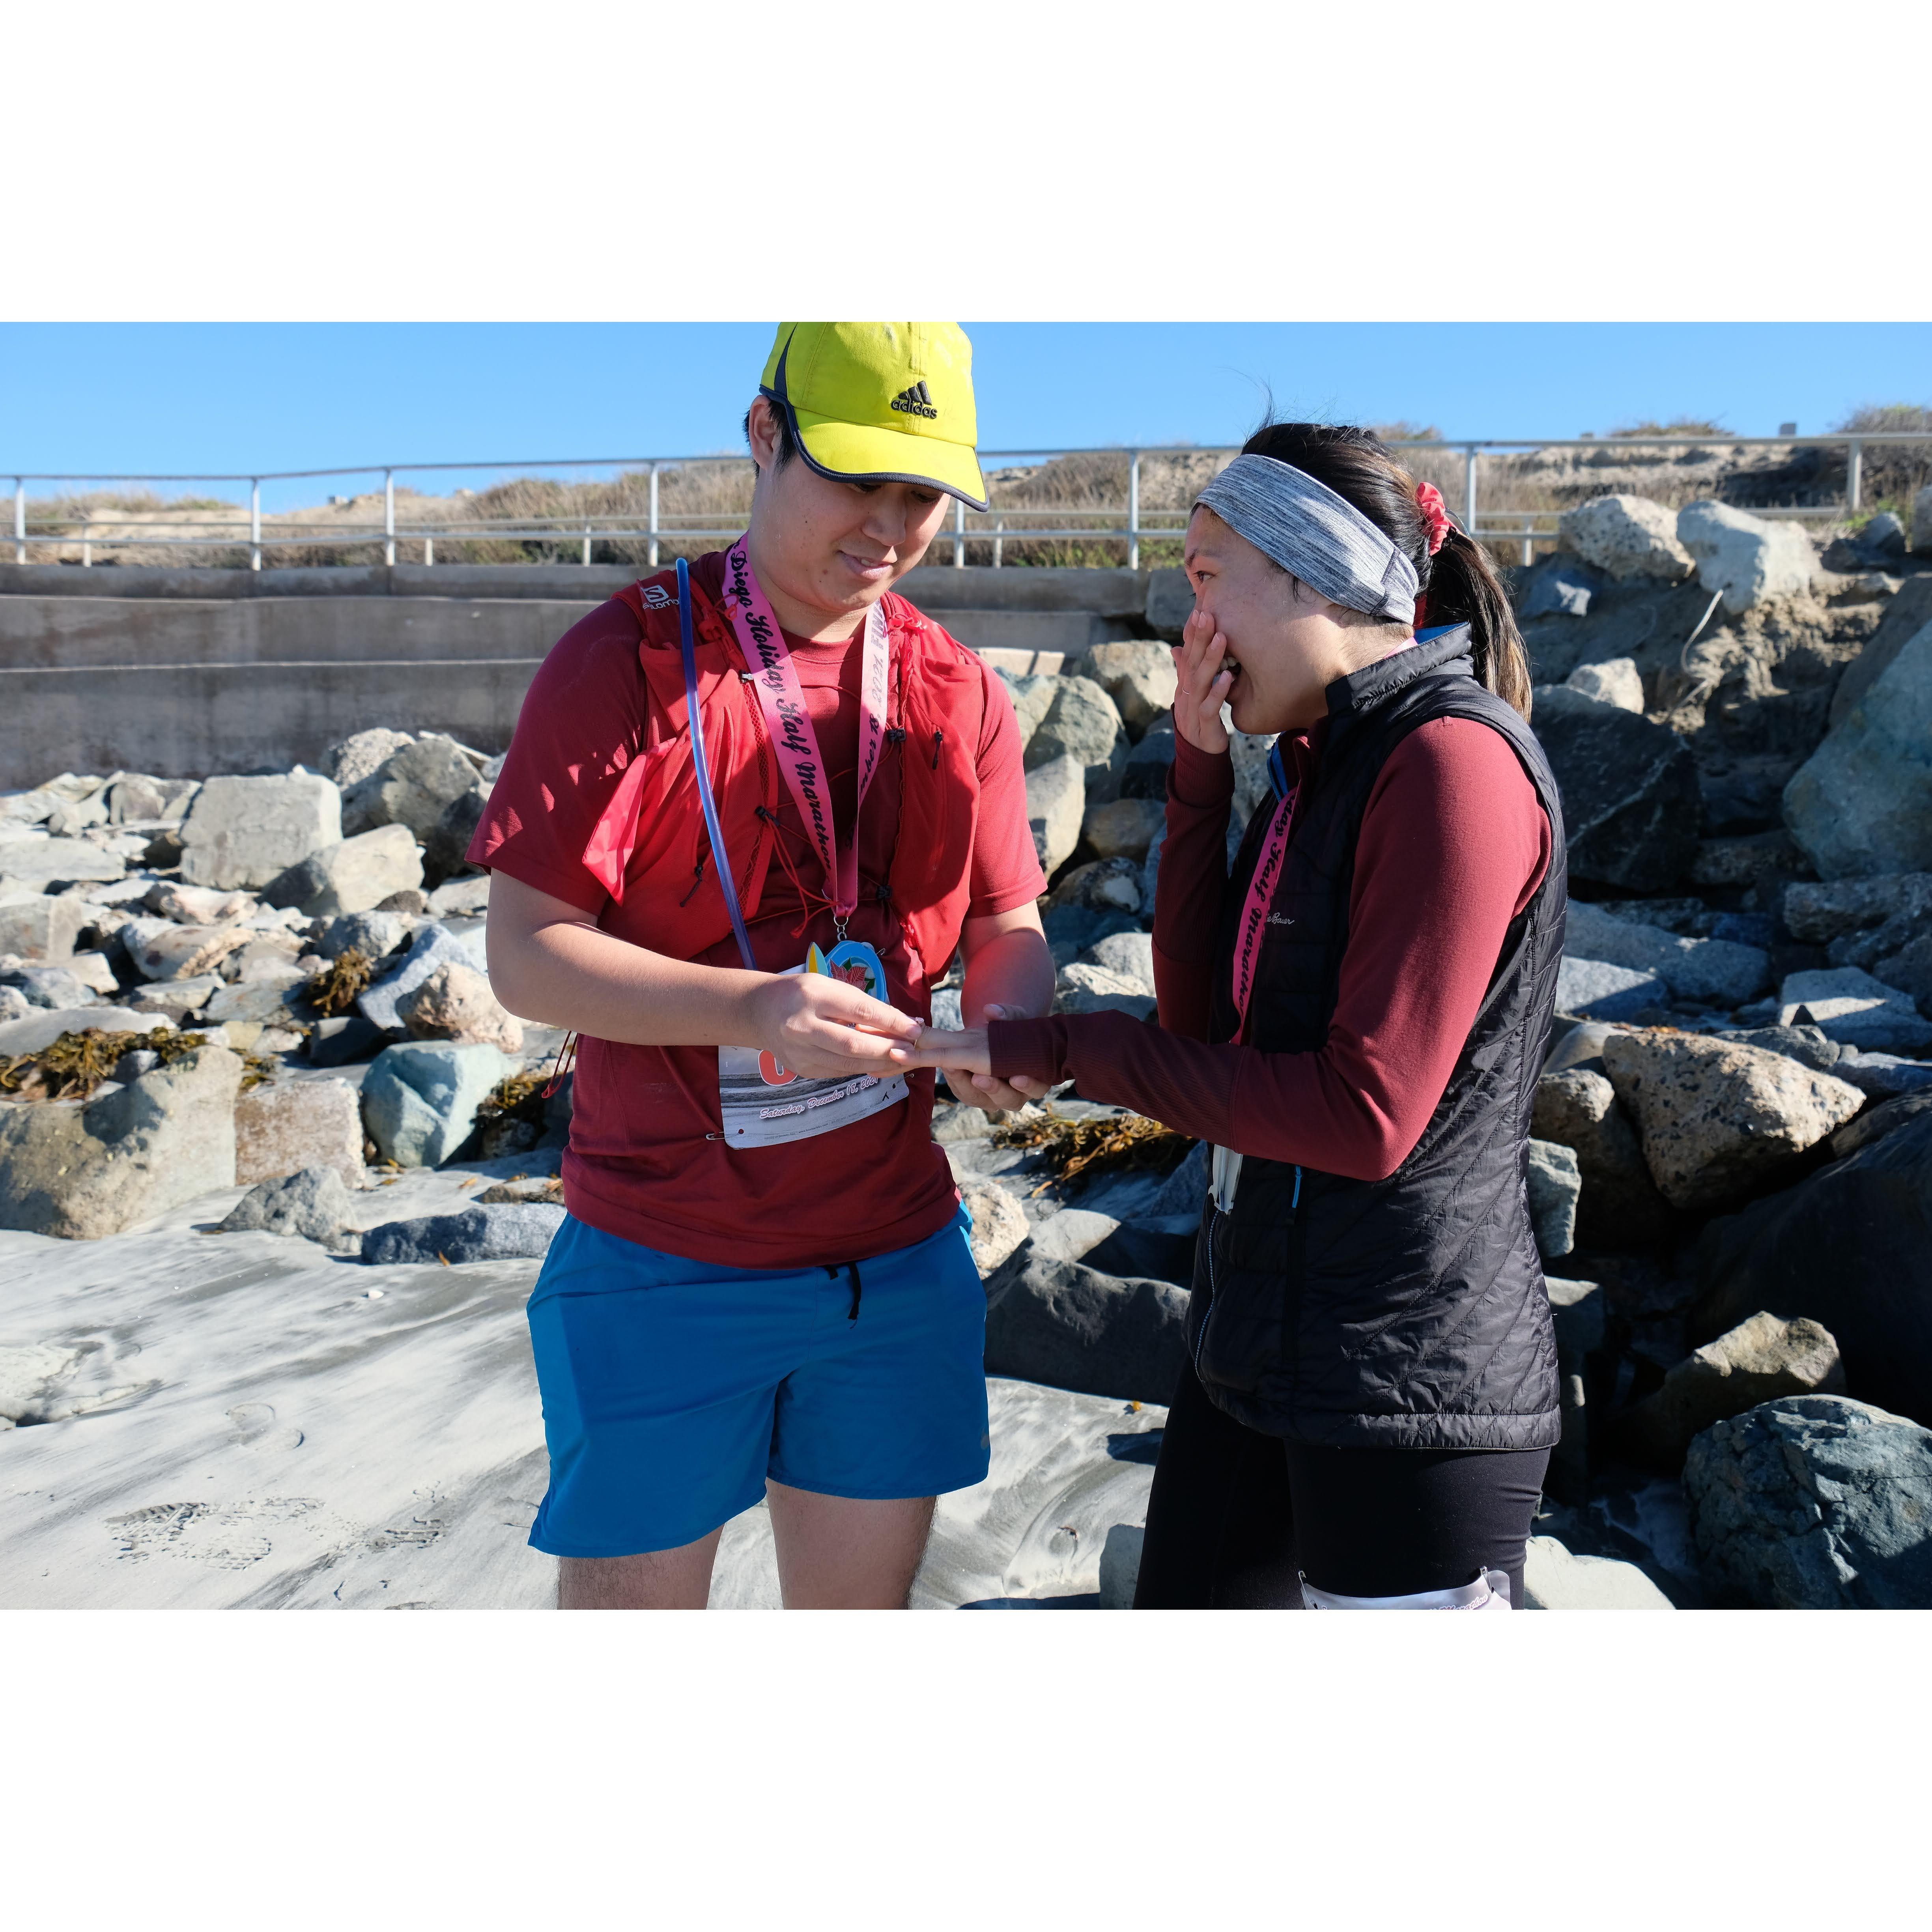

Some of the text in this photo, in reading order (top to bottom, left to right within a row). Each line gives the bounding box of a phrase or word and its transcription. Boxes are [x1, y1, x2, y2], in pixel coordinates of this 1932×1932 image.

[891, 398, 938, 419] adidas
[729, 551, 831, 871] Diego Holiday Half Marathon
[1255, 842, 1282, 902] Half
[760, 1105, 805, 1119] Saturday,
[807, 1089, 845, 1109] December
[846, 1082, 858, 1095] 18,
